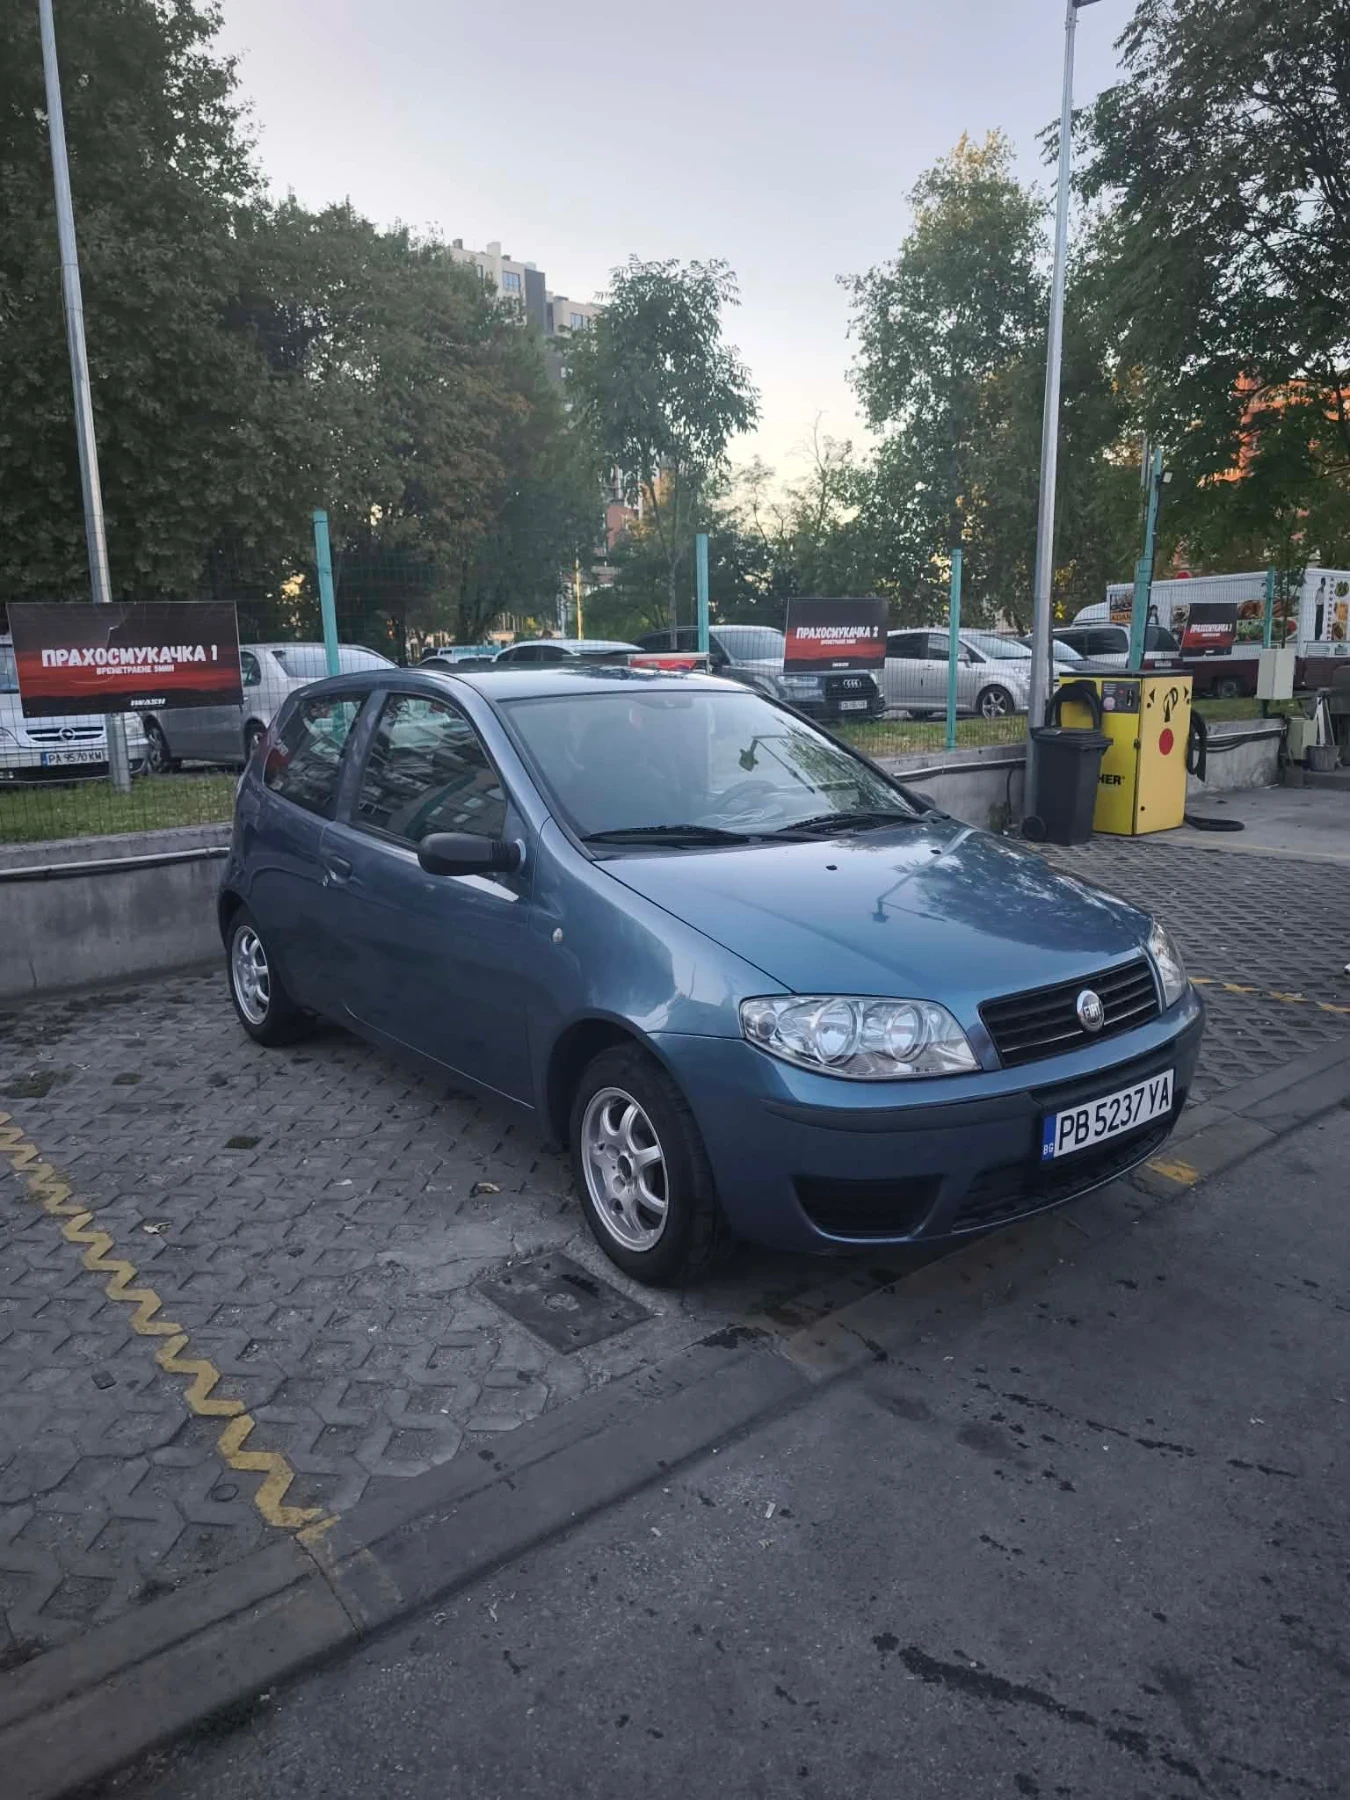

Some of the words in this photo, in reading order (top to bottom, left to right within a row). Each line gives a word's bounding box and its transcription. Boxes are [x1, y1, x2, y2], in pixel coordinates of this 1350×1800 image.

[795, 626, 871, 639] ПРАХОСМУКАЧКА
[872, 625, 879, 637] 2
[41, 644, 207, 668] ПРАХОСМУКАЧКА
[210, 644, 218, 661] 1
[1083, 1002, 1101, 1018] FIAT
[1058, 1109, 1090, 1151] PB
[1094, 1087, 1145, 1137] 5237
[1148, 1076, 1169, 1115] YA
[1042, 1142, 1054, 1155] BG
